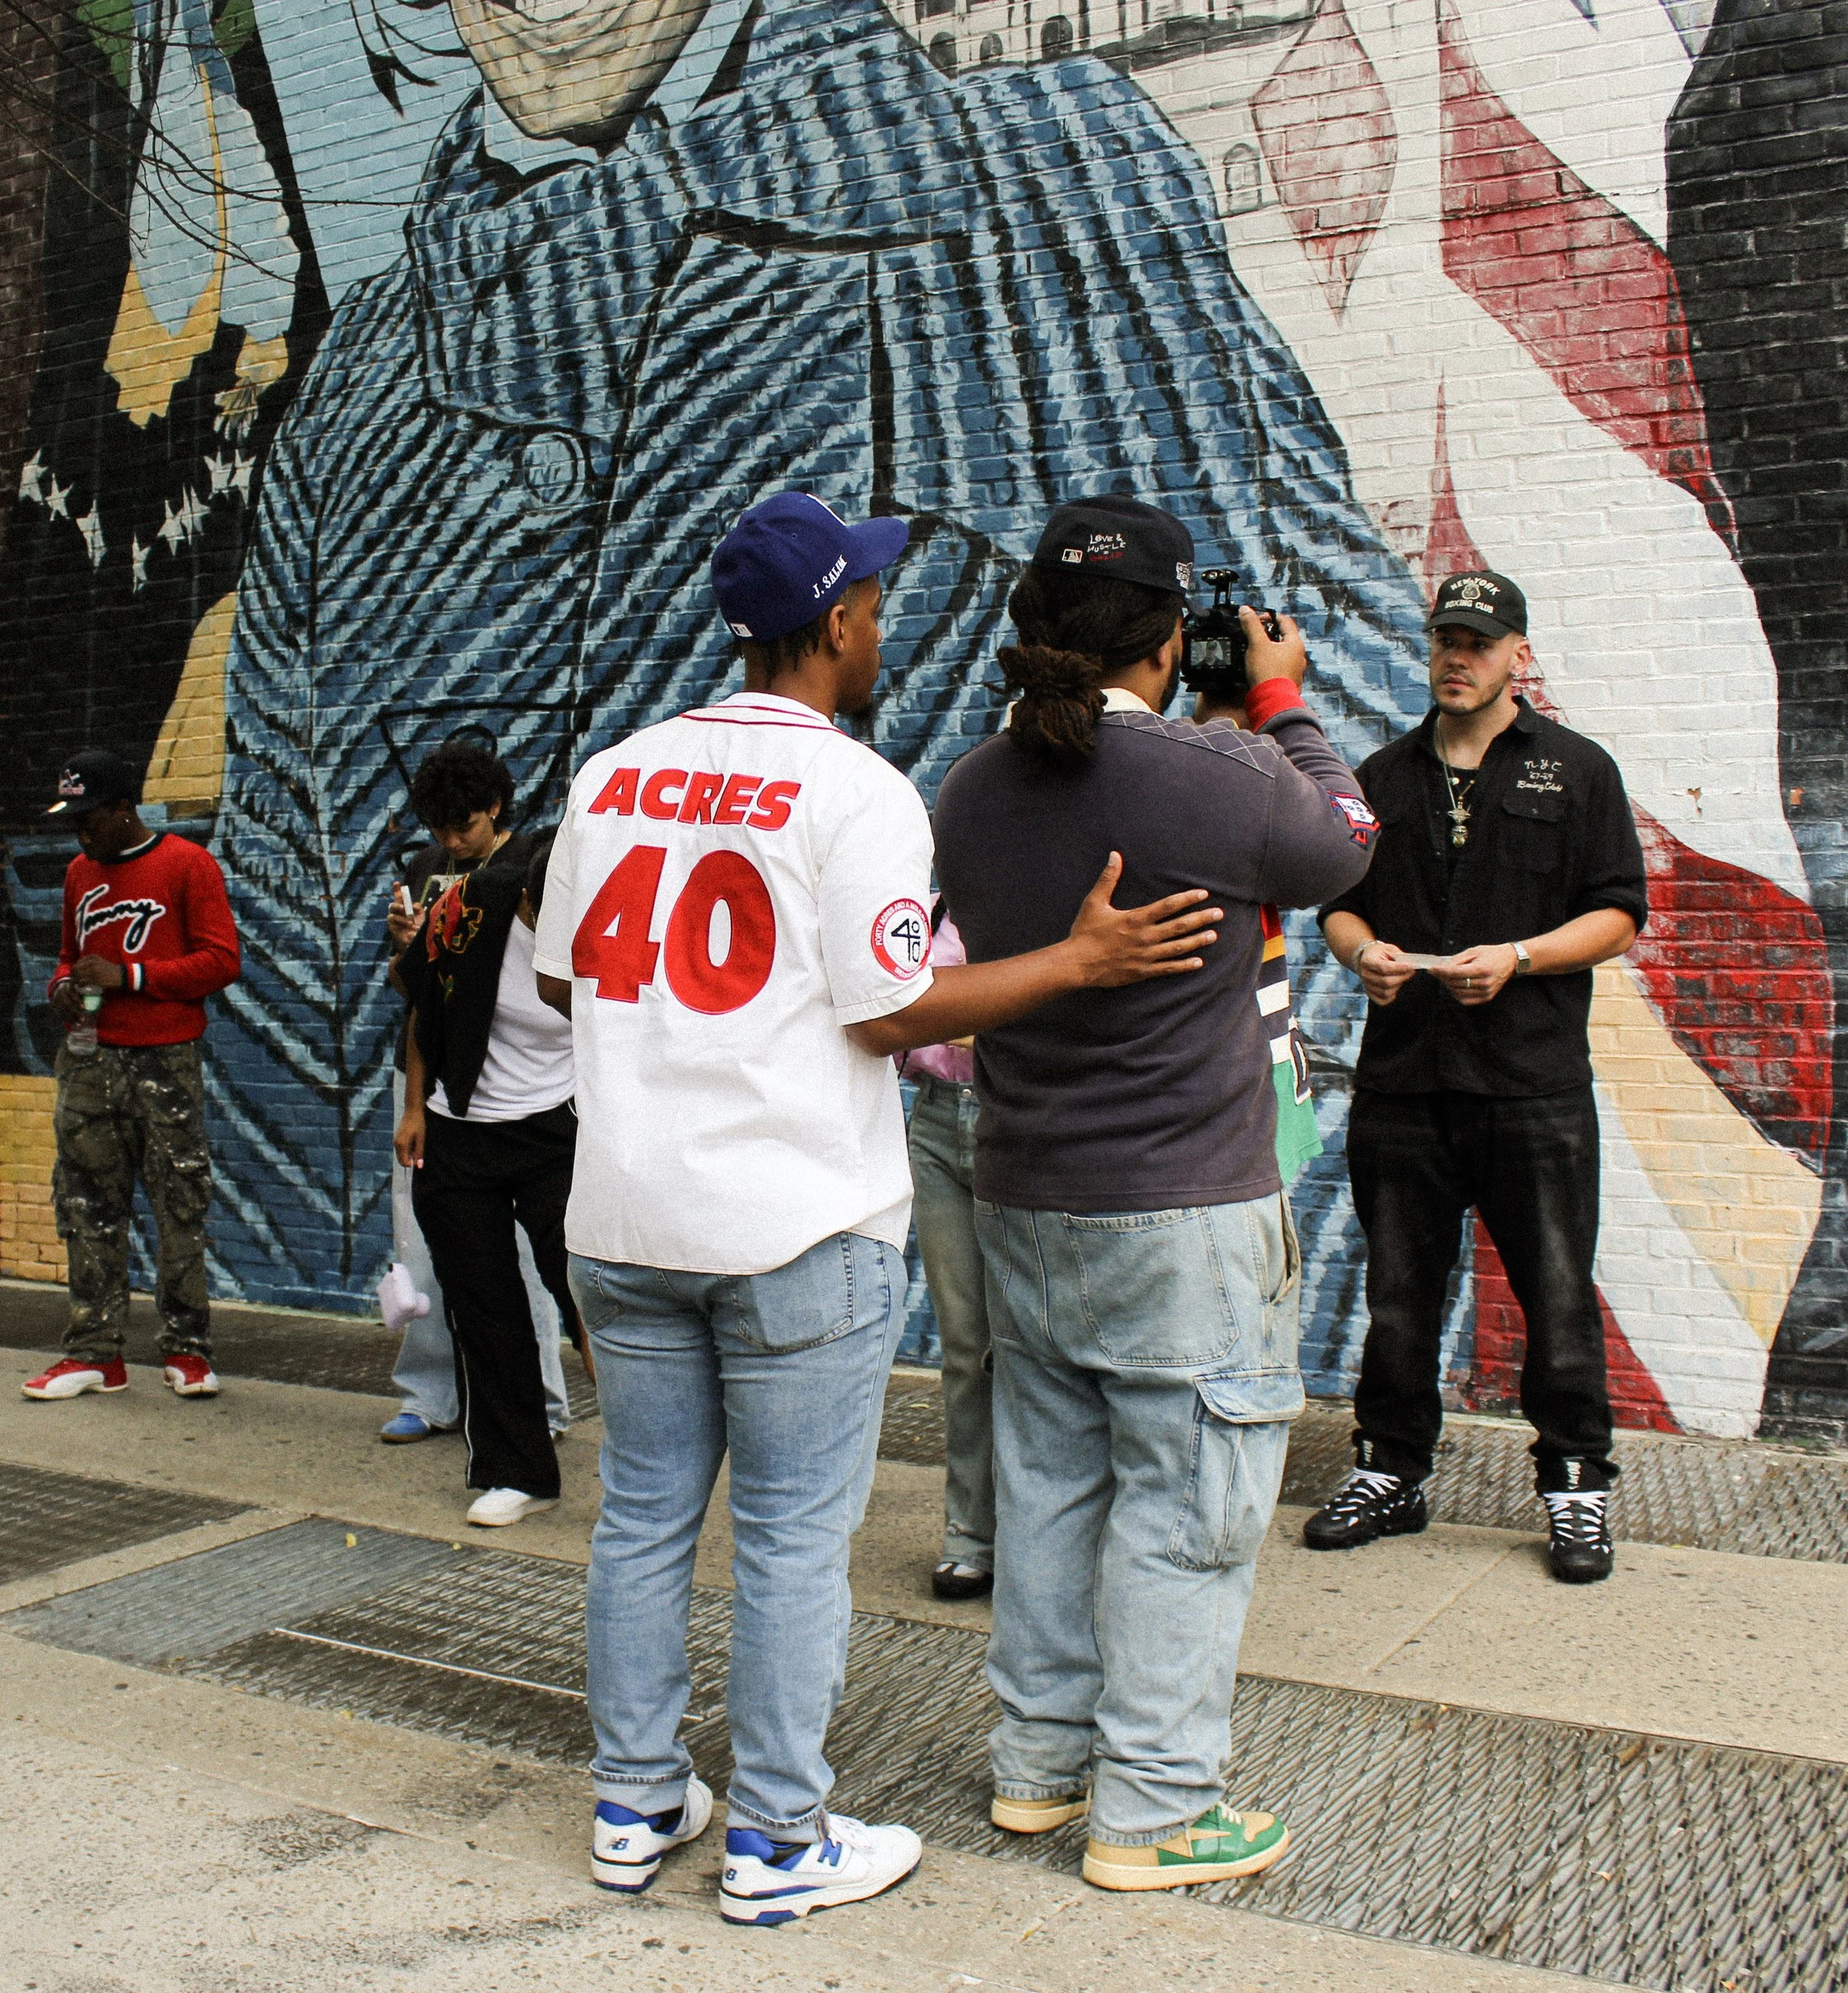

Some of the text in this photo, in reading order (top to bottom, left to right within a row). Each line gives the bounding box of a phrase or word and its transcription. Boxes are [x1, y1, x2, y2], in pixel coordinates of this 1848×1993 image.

[1087, 542, 1127, 552] HUSTLE
[1090, 534, 1113, 544] LOVE
[813, 554, 848, 599] J. SALIM
[1450, 577, 1501, 596] NEW YORK
[1444, 599, 1494, 614] BOXING CLUB
[588, 767, 801, 832] ACRES
[75, 883, 166, 954] Tommy
[571, 844, 776, 1015] 40
[874, 923, 884, 946] FORTY
[879, 906, 895, 926] ACRES
[894, 901, 906, 911] AND
